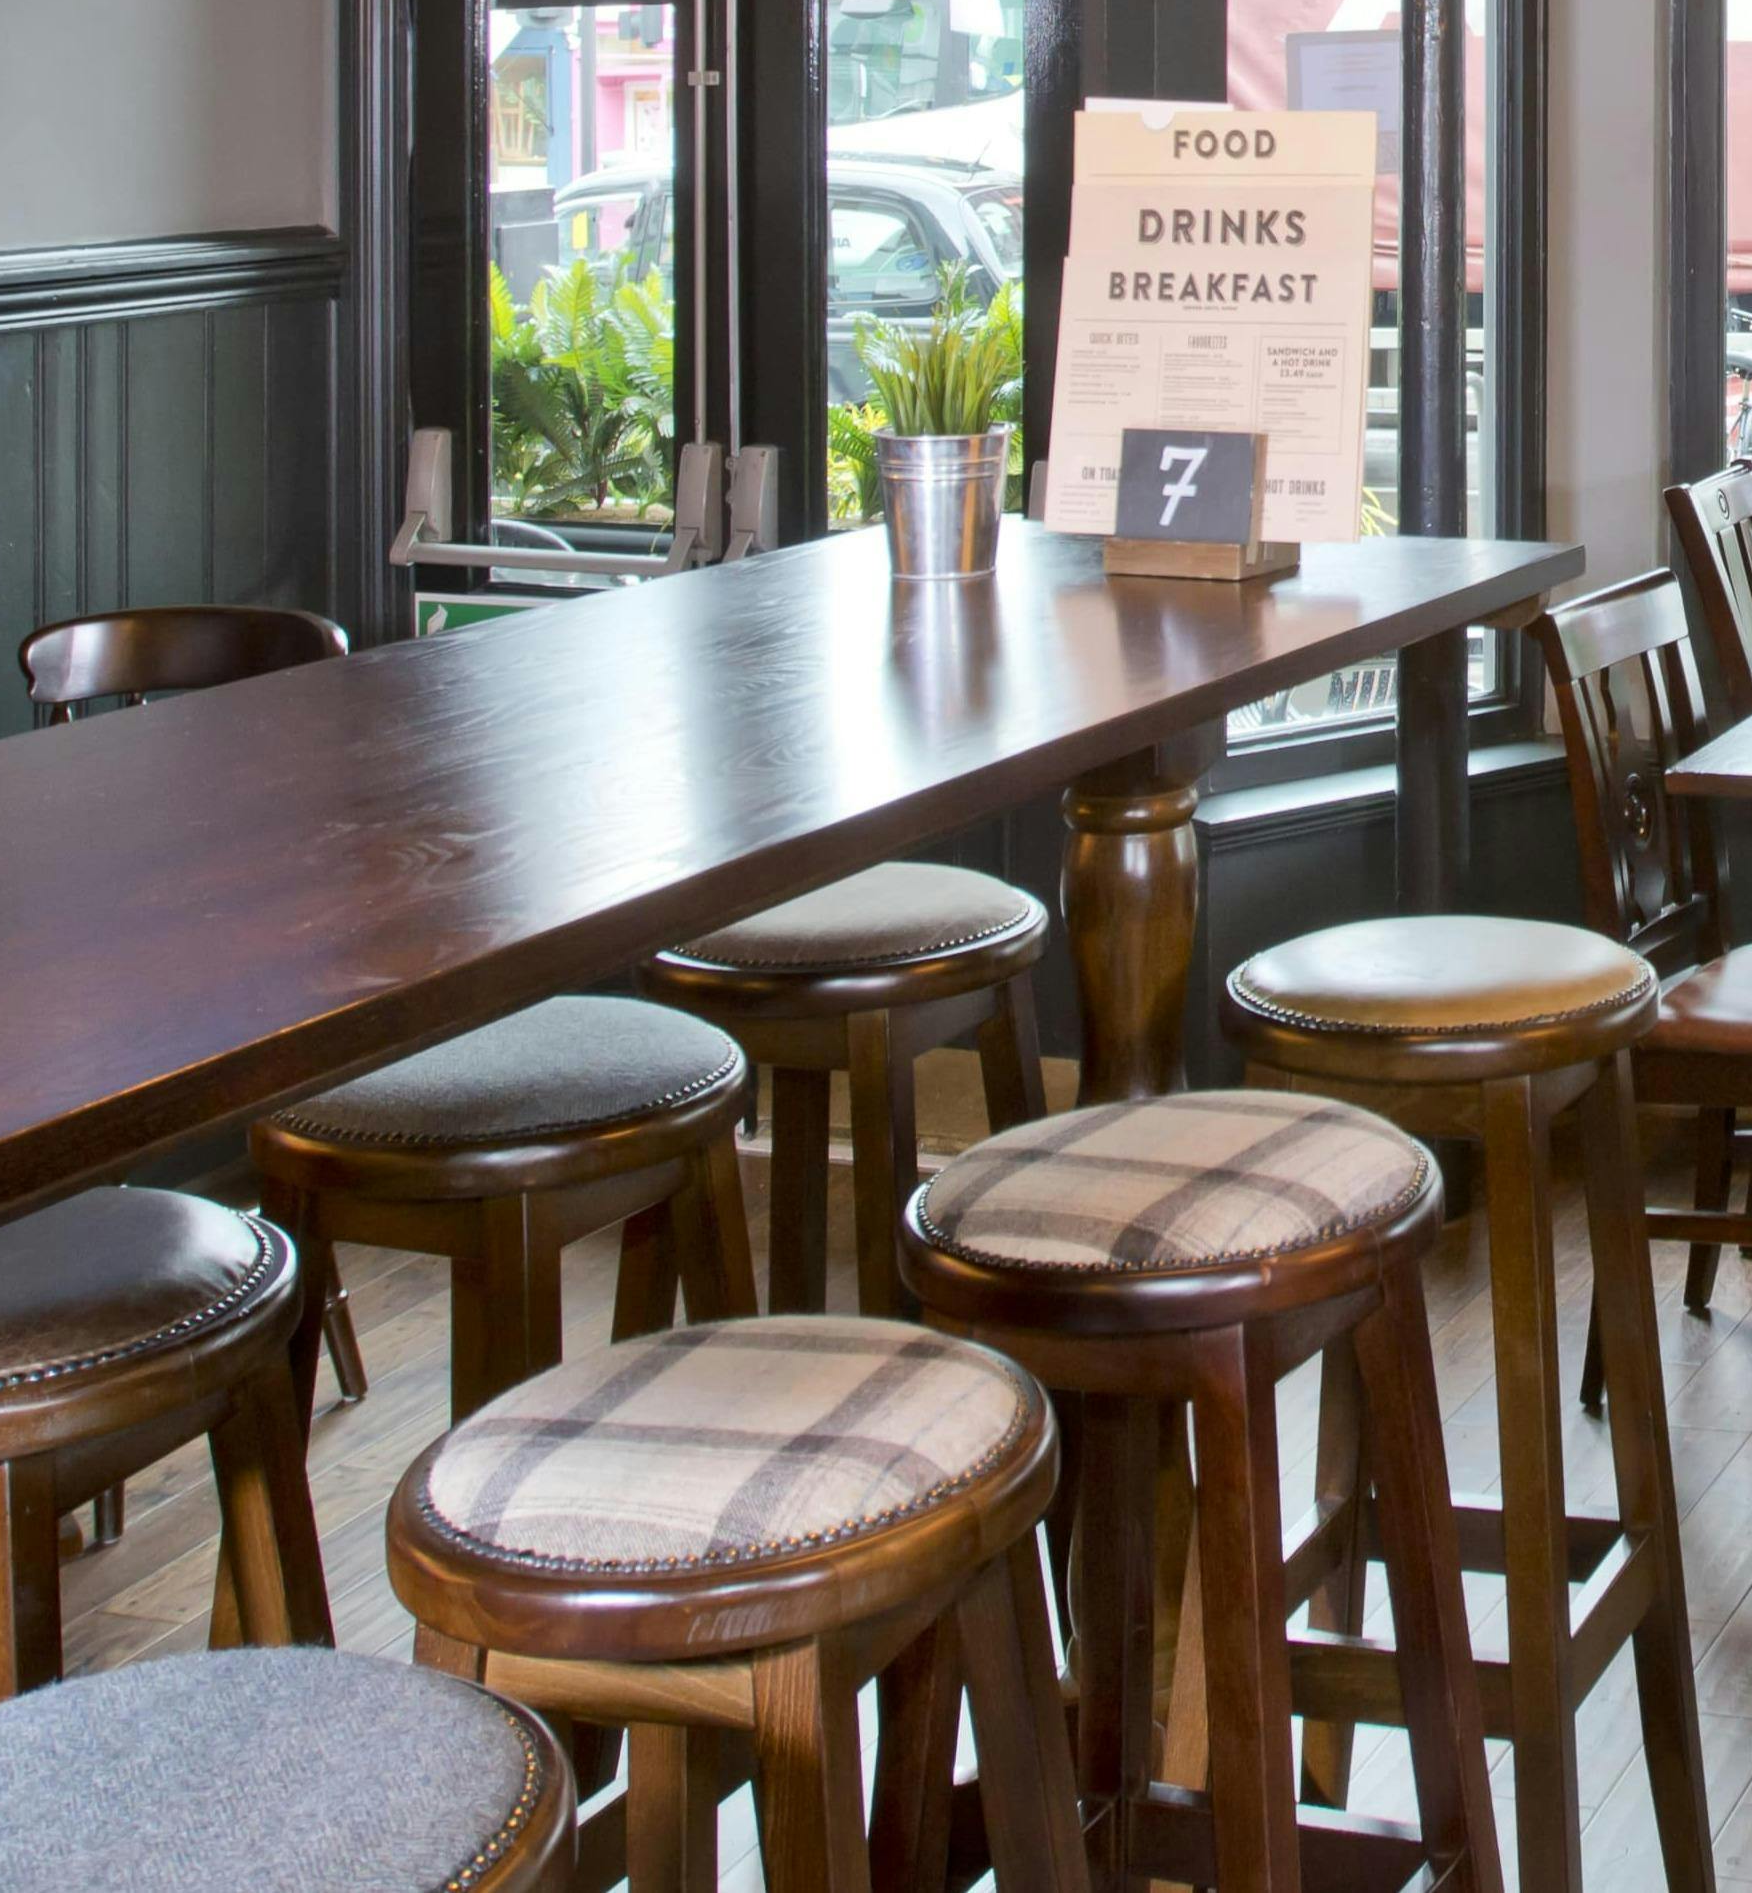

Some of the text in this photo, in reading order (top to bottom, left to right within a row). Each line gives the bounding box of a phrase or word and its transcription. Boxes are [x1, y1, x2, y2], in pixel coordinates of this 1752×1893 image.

[1173, 129, 1277, 159] FOOD
[1138, 208, 1308, 246] DRINKS
[1108, 271, 1319, 304] BREAKFAST
[1099, 467, 1120, 482] TOA
[1159, 445, 1208, 526] 7
